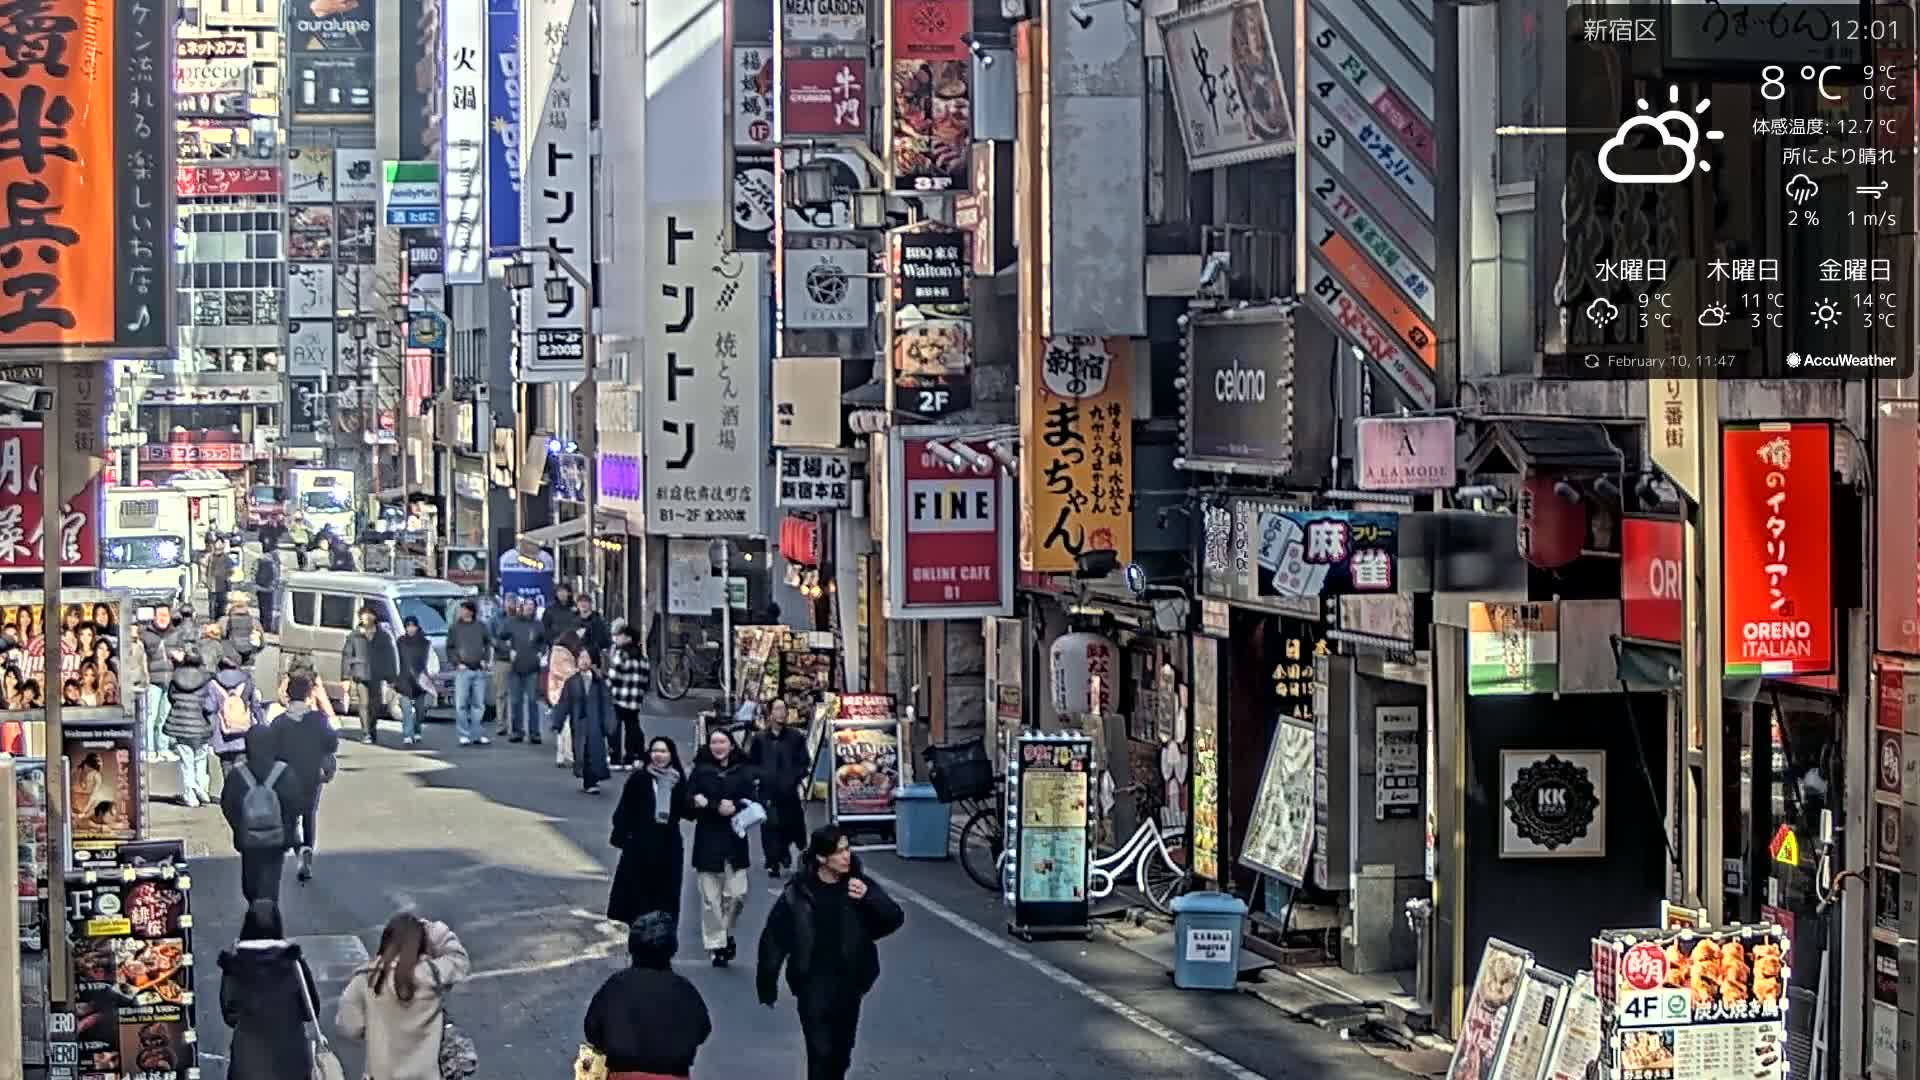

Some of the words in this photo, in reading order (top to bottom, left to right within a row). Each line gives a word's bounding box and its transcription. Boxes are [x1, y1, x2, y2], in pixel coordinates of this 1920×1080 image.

[785, 0, 813, 13] MEAT
[818, 0, 864, 14] GARDEN
[1316, 28, 1336, 48] 5
[453, 46, 477, 110] 火鍋
[1316, 81, 1335, 97] 4
[1316, 128, 1336, 149] 3
[1359, 123, 1415, 185] センチュリー
[1315, 178, 1336, 201] 2
[904, 261, 960, 279] Walton's
[1315, 275, 1342, 305] B1
[661, 216, 694, 469] トントン
[1067, 378, 1087, 394] の
[1215, 360, 1265, 402] celona
[919, 391, 949, 411] 2F
[783, 457, 847, 478] 酒場心
[1043, 402, 1088, 555] まっちゃん
[782, 481, 847, 500] 新宿本店
[914, 491, 989, 520] FINE
[1352, 526, 1392, 540] フリー
[1756, 436, 1791, 610] 俺のイタリアン
[912, 567, 956, 582] ONLINE
[960, 565, 990, 580] CAFE
[1744, 621, 1811, 640] ORENO
[1744, 641, 1811, 657] ITALIAN
[1538, 788, 1566, 804] KK
[1625, 996, 1658, 1018] 4F
